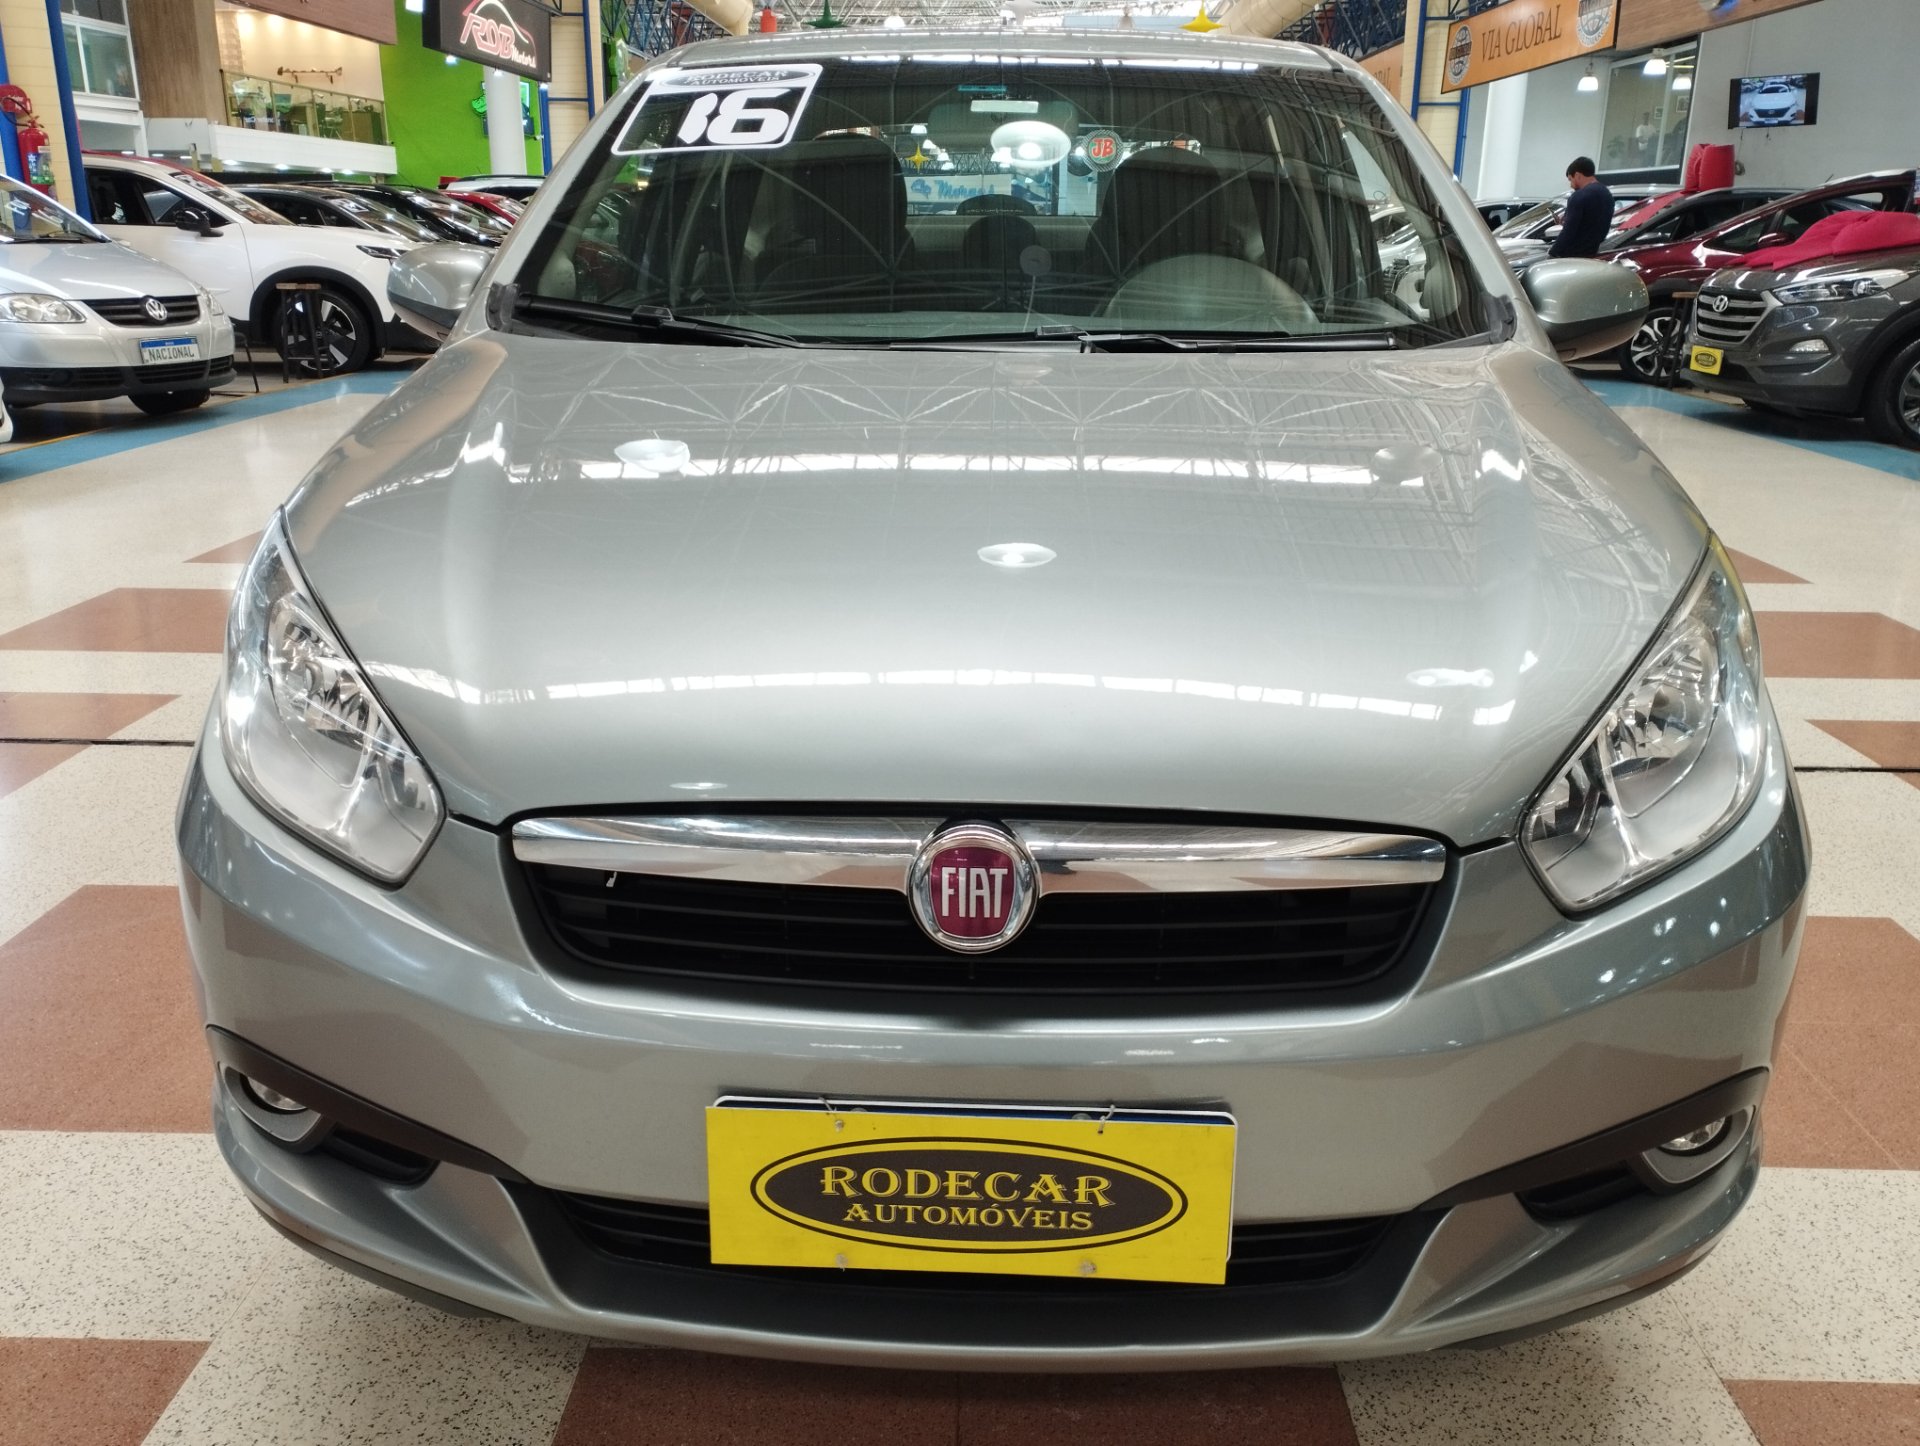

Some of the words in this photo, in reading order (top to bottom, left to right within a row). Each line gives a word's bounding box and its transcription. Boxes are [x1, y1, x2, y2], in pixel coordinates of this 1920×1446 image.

[1482, 27, 1502, 62] VIA
[1505, 4, 1562, 56] GLOBAL
[677, 88, 789, 145] 16
[1091, 137, 1115, 158] JB
[148, 345, 195, 361] NACIONAL
[941, 866, 1009, 918] FIAT
[820, 1166, 1116, 1208] RODECAR
[843, 1203, 1094, 1230] AUTOMÓVEIS
